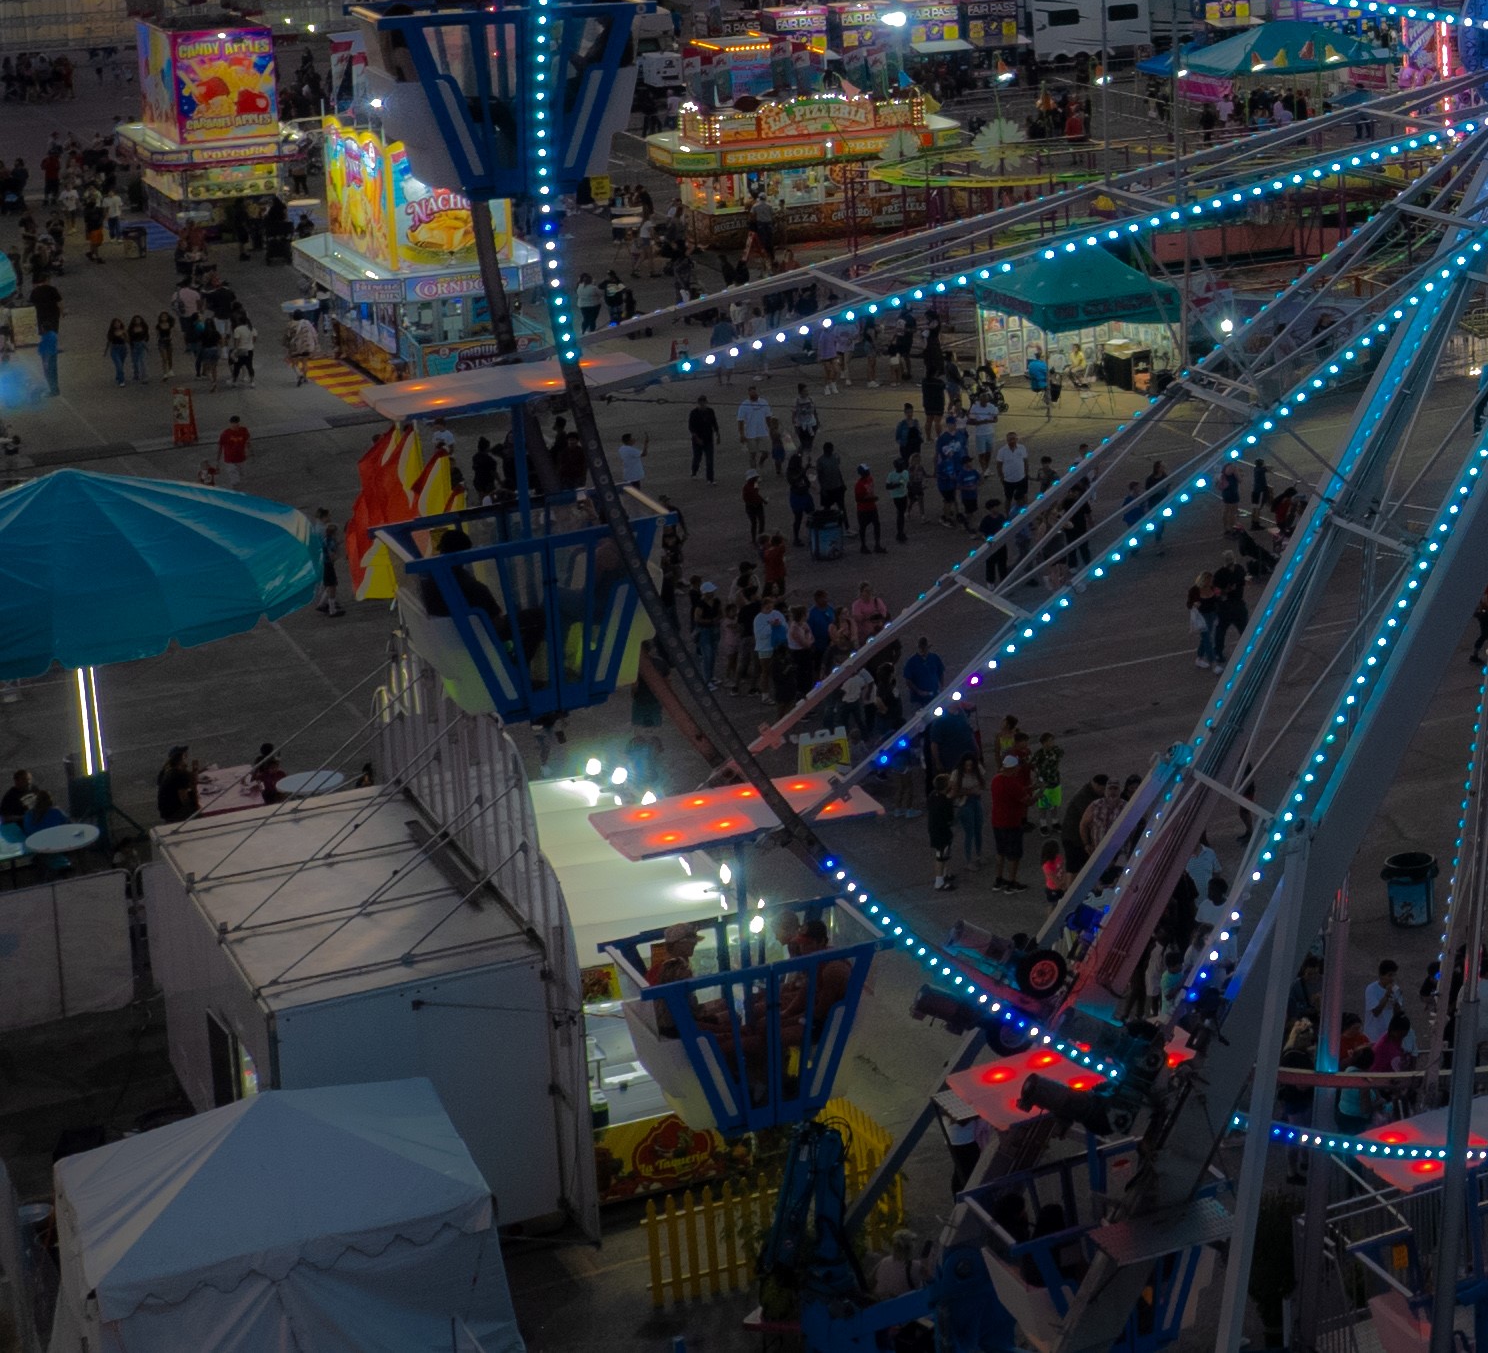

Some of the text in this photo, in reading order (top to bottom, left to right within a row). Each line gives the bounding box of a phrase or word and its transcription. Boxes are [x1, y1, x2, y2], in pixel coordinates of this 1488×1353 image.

[932, 5, 958, 18] PASS
[968, 3, 1017, 16] FAIR PASS
[776, 17, 827, 30] FAIR PASS
[842, 13, 864, 25] FAIR
[178, 38, 271, 59] CANDY APPLES
[768, 112, 791, 130] LA
[795, 102, 867, 124] PIZZERIA
